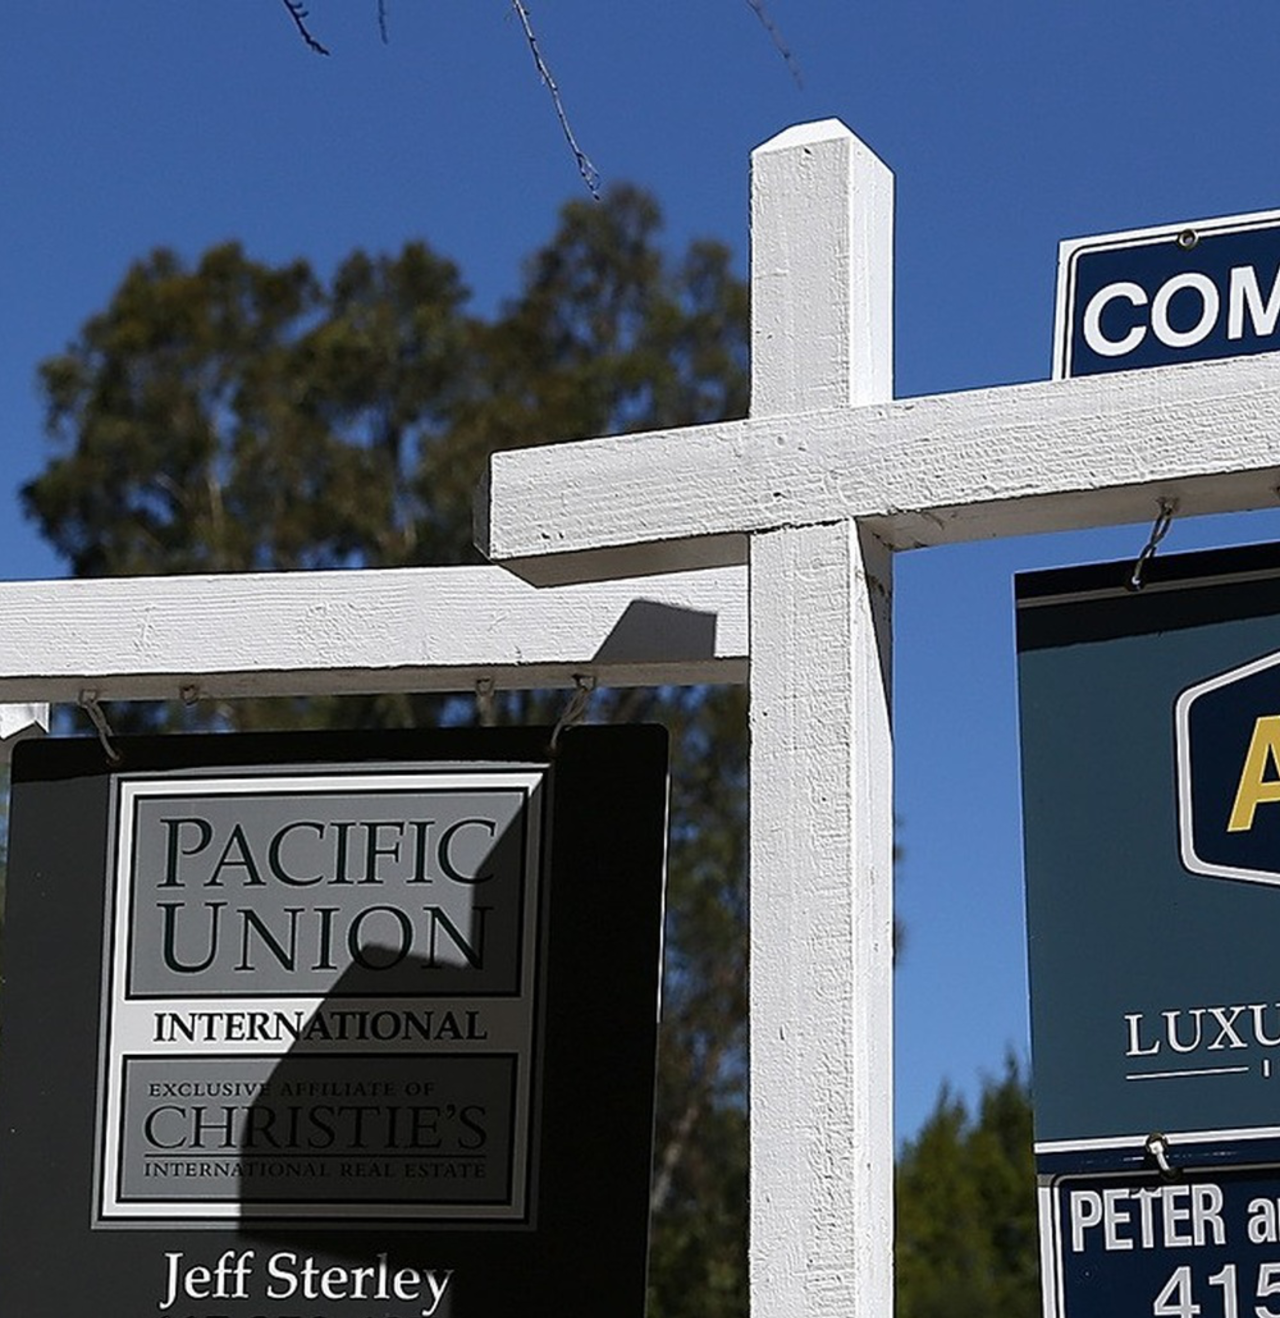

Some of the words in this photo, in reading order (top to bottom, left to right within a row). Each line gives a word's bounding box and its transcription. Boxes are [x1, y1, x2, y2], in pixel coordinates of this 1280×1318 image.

[157, 817, 496, 889] PACIFIC
[157, 901, 493, 973] UNION
[153, 1010, 488, 1044] INTERNATIONAL
[148, 1082, 272, 1098] EXCLUSIVE
[280, 1082, 397, 1098] AFFILIATE
[405, 1082, 435, 1098] OF
[144, 1104, 488, 1151] CHRISTIE'S
[144, 1161, 327, 1179] INTERNATIONAL
[340, 1161, 396, 1179] REAL
[404, 1161, 486, 1179] ESTATE
[1070, 1182, 1226, 1253] PETER
[159, 1250, 256, 1311] Jeff
[266, 1252, 453, 1316] Sterley
